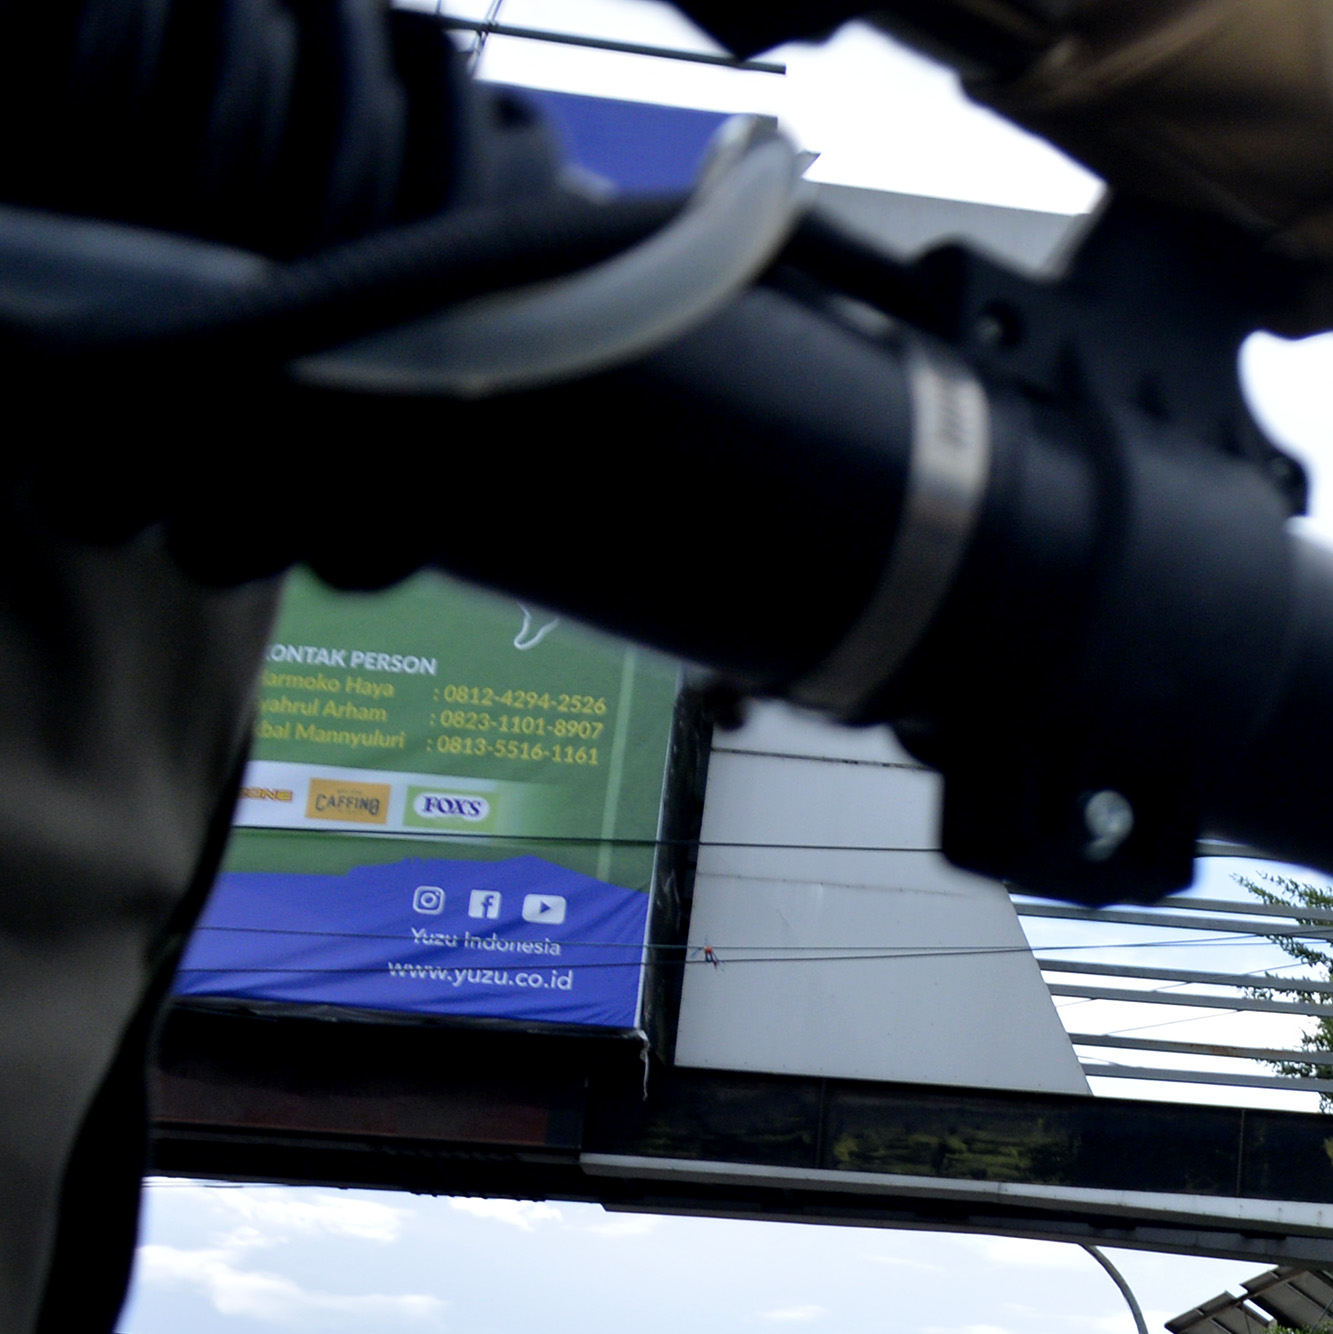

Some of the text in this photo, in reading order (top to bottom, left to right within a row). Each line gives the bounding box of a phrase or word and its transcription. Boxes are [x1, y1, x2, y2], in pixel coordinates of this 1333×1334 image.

[266, 643, 438, 676] ONTAK PERSON
[261, 669, 340, 692] armoko
[345, 676, 395, 699] Haya
[443, 684, 607, 715] 0812-4294-2526
[258, 695, 320, 716] yahrul
[322, 700, 388, 722] Arham
[439, 709, 605, 740] 0823-1101-8907
[295, 723, 406, 749] Mannyuluri
[436, 735, 599, 765] 0813-5516-1161
[315, 793, 380, 815] CAFFINO
[411, 926, 562, 956] Yuzu Indonesia
[388, 961, 574, 990] www.yuzu.co.id
